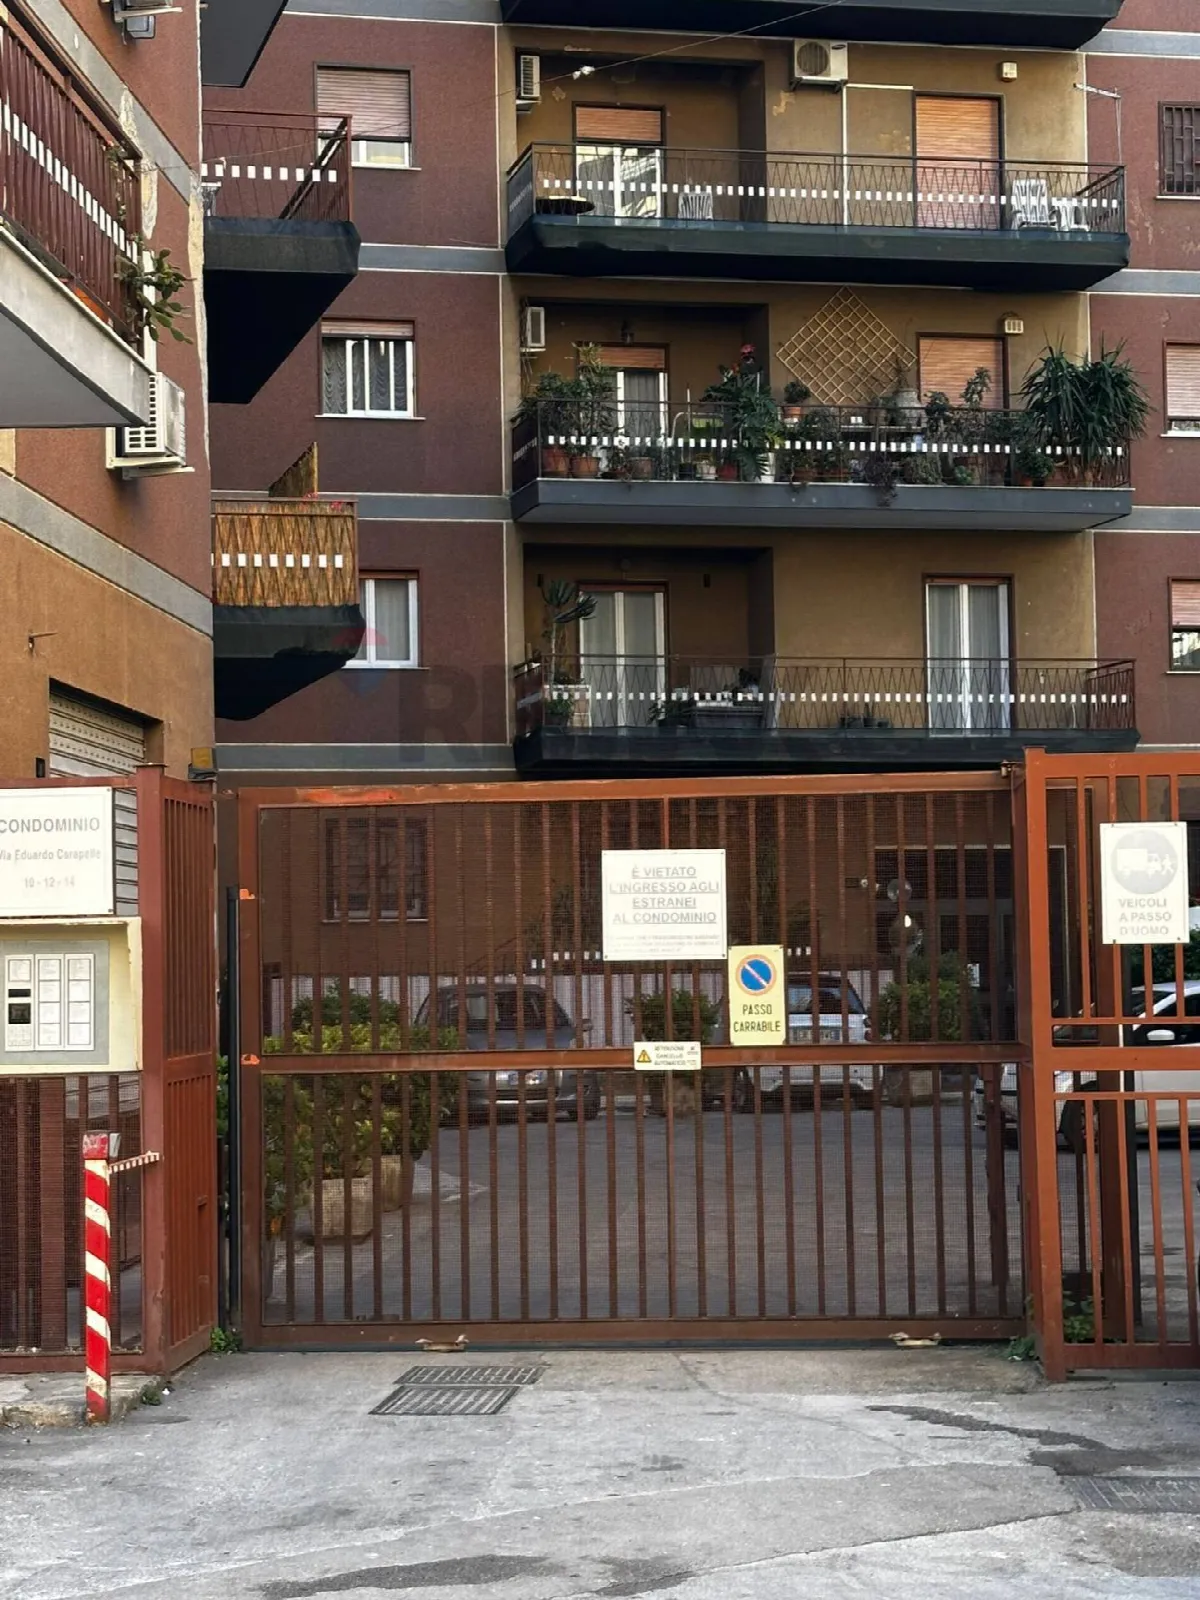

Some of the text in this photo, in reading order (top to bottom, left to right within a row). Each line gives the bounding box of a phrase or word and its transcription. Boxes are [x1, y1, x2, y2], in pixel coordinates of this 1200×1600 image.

[0, 817, 100, 833] CONDOMINIO
[15, 849, 54, 860] Eduardo
[644, 866, 697, 877] VIETATO
[609, 881, 719, 892] L'INGRESSO AGLI
[632, 897, 696, 908] ESTRANEI
[1118, 899, 1167, 908] VEICOLI
[613, 912, 717, 923] AL CONDOMINIO
[1130, 911, 1172, 922] PASSO
[742, 1004, 772, 1015] PASSO
[733, 1021, 781, 1032] CARRABILE
